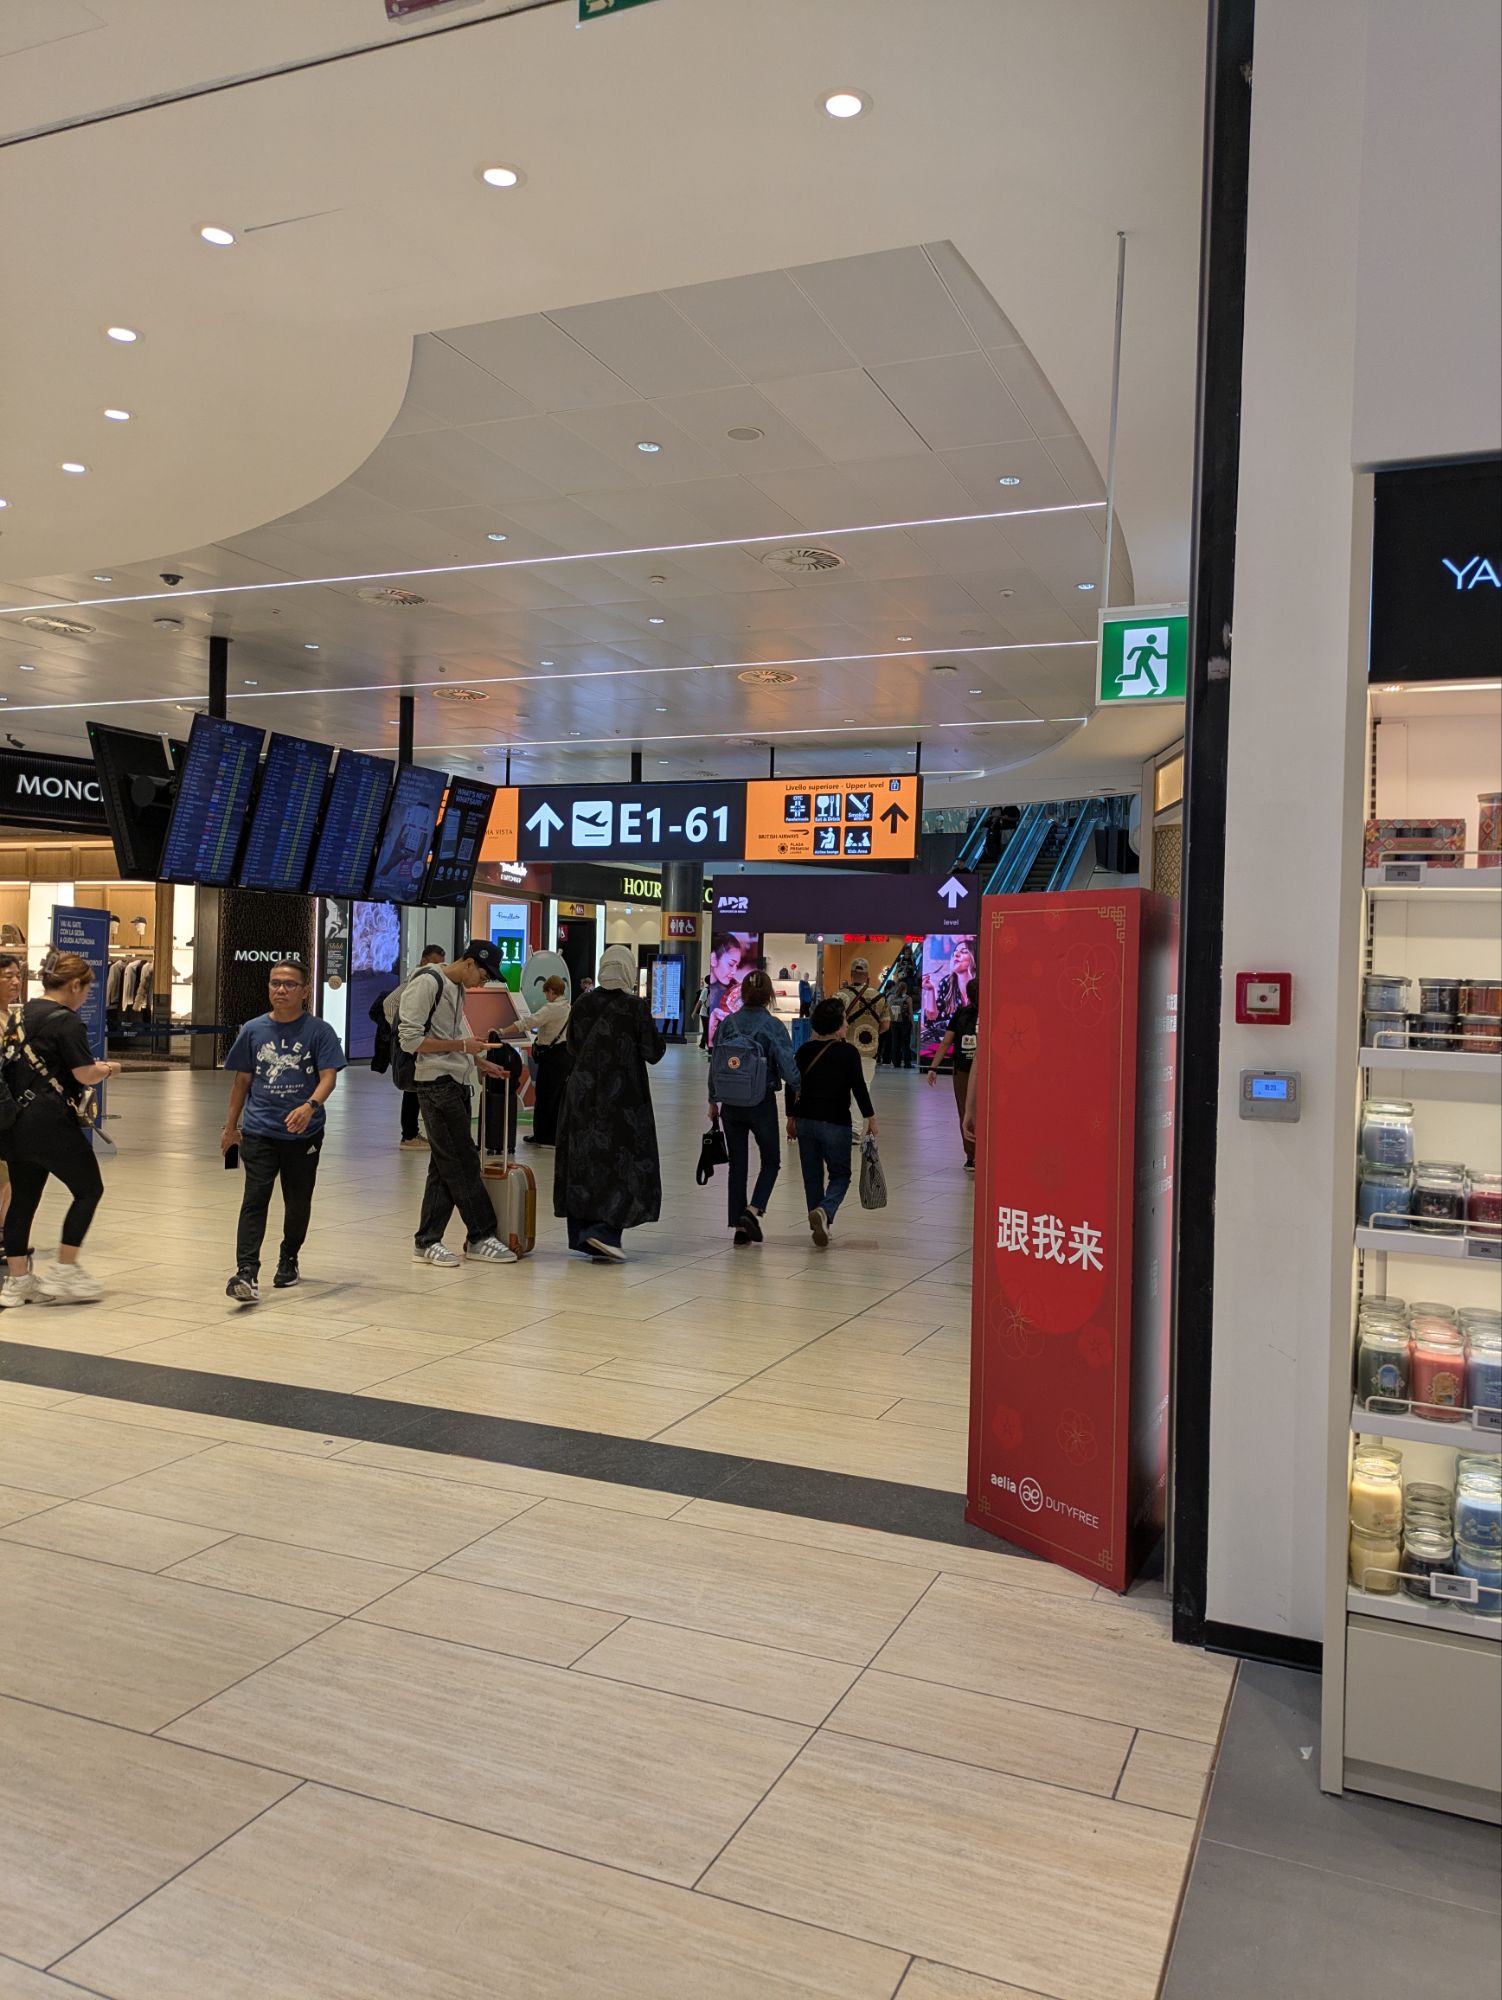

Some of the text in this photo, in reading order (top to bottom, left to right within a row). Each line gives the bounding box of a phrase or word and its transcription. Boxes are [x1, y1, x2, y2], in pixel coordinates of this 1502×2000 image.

[16, 774, 104, 802] MONC
[846, 782, 866, 790] Upper
[620, 802, 729, 843] E1-61
[718, 896, 749, 910] ADR
[996, 1206, 1104, 1272] 跟我来
[991, 1473, 1016, 1494] aelia
[1046, 1497, 1100, 1529] DUTYFREE
